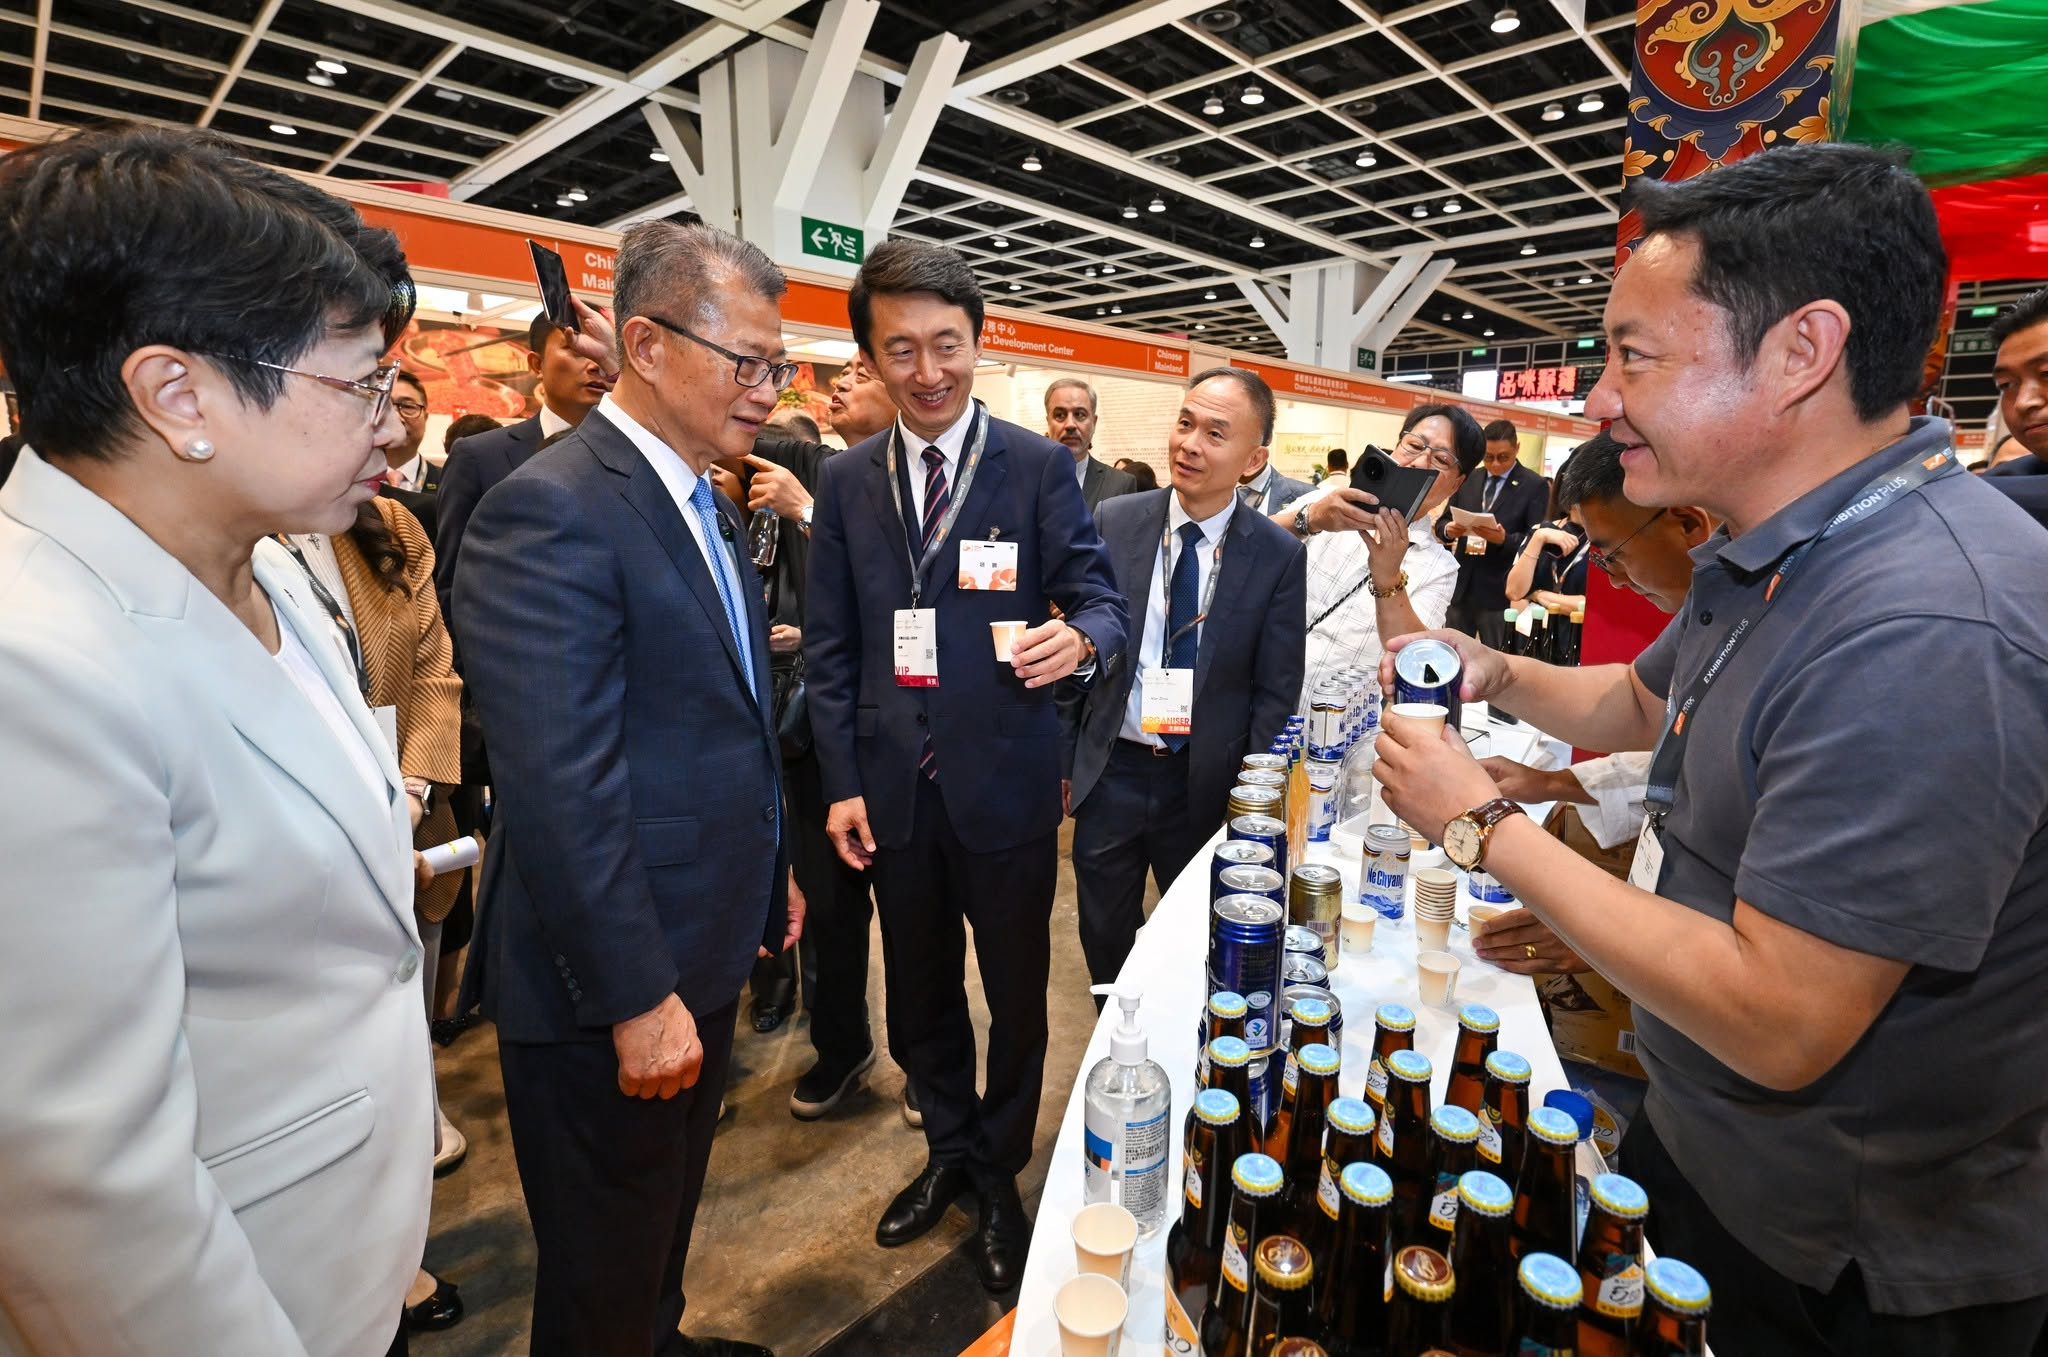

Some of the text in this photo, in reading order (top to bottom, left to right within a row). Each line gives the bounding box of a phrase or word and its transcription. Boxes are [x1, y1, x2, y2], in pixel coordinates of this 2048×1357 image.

[584, 252, 615, 270] Chi
[992, 335, 1047, 352] Development
[1047, 343, 1075, 356] Center
[1156, 349, 1183, 362] Chinese
[1154, 361, 1184, 374] Mainland
[895, 666, 910, 676] VIP
[1142, 716, 1190, 726] ORGANISER
[1366, 867, 1405, 889] Ne Chyang
